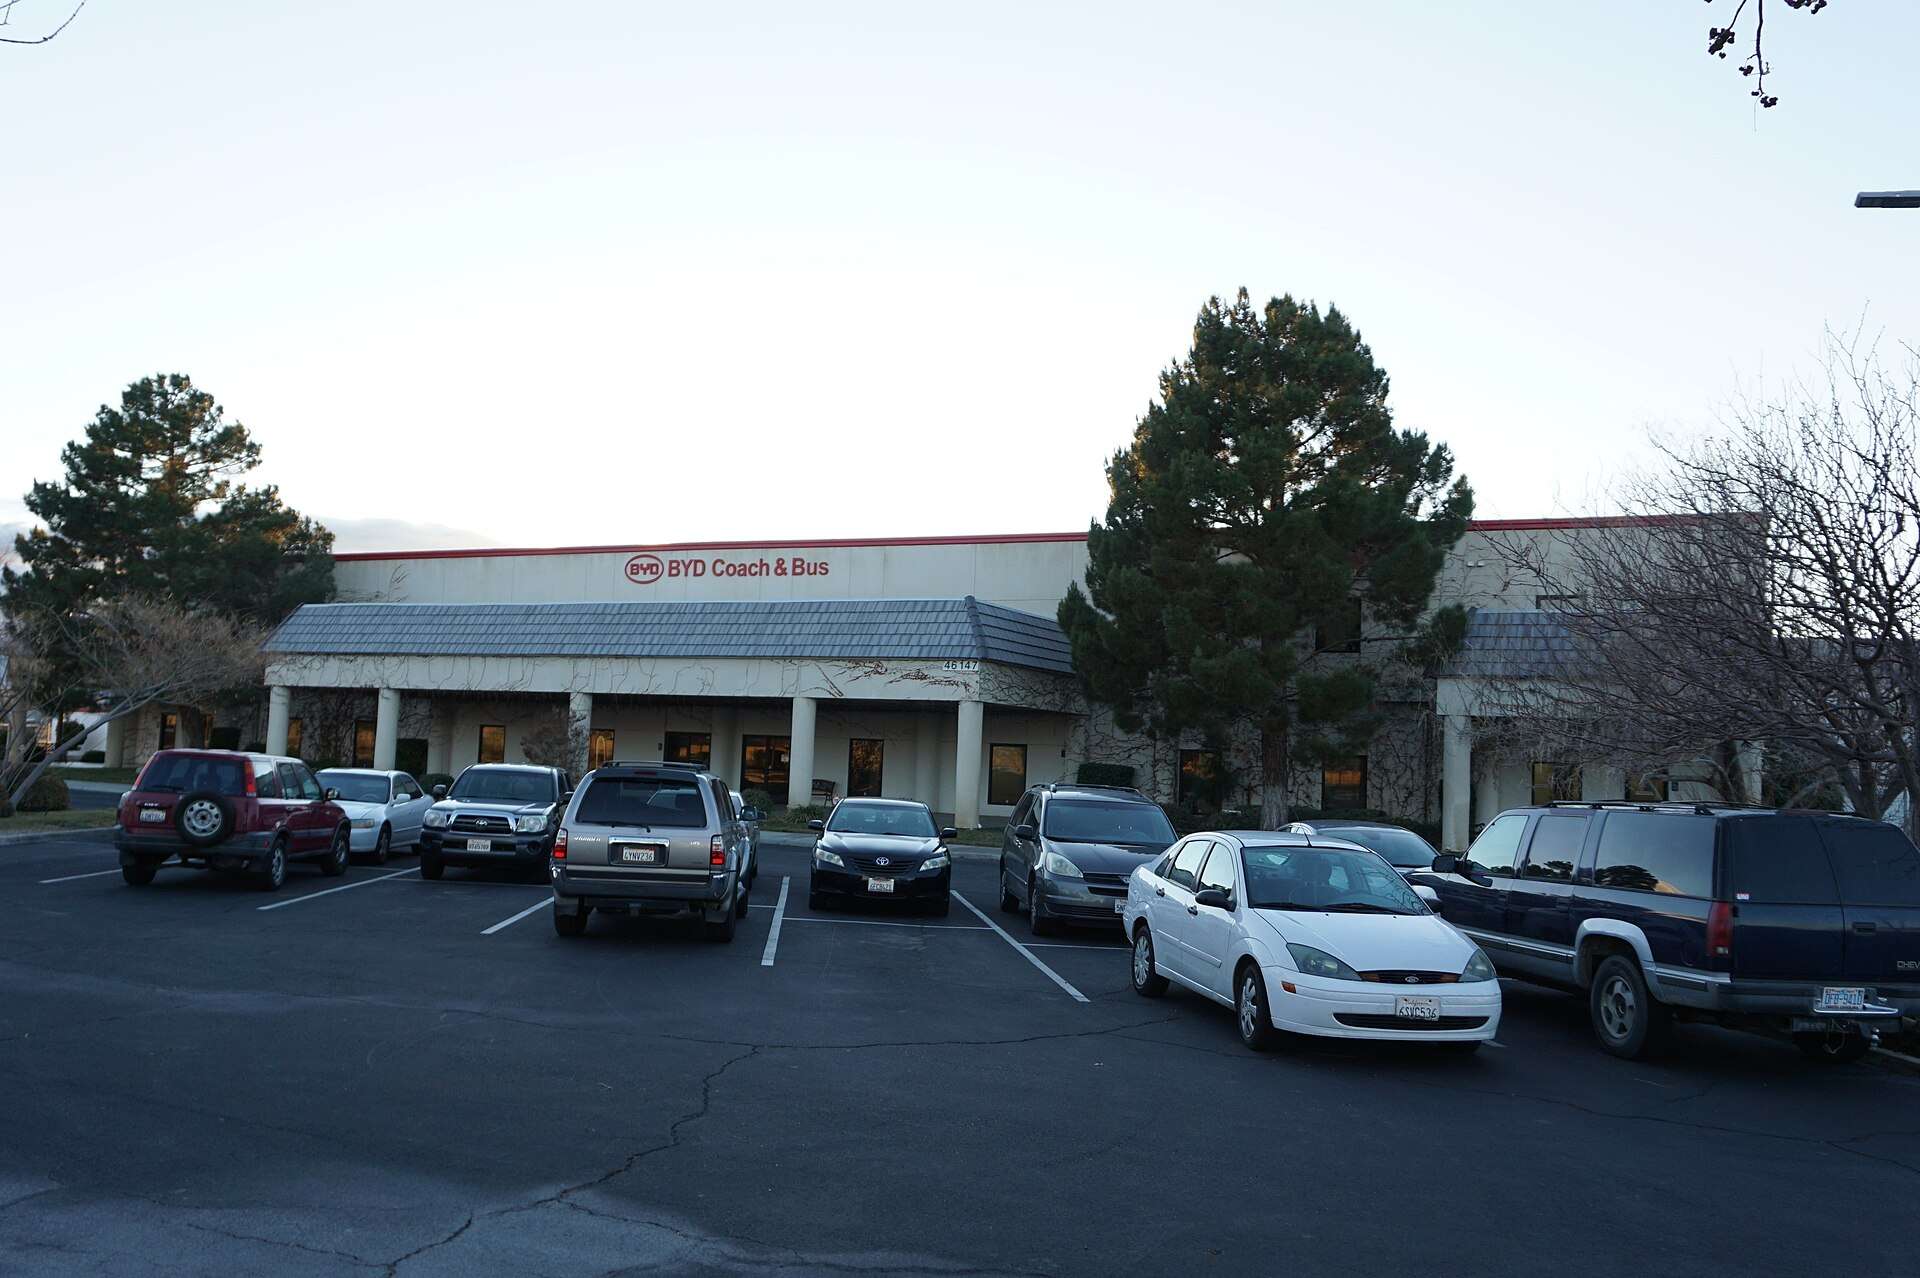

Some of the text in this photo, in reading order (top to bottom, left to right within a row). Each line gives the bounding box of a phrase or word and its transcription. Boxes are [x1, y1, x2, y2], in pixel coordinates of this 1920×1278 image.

[629, 563, 659, 575] BYD
[668, 557, 829, 577] BYD Coach & Bus
[944, 660, 977, 670] 46147
[1897, 960, 1920, 969] CHEV
[1399, 1006, 1438, 1019] 6SVC536
